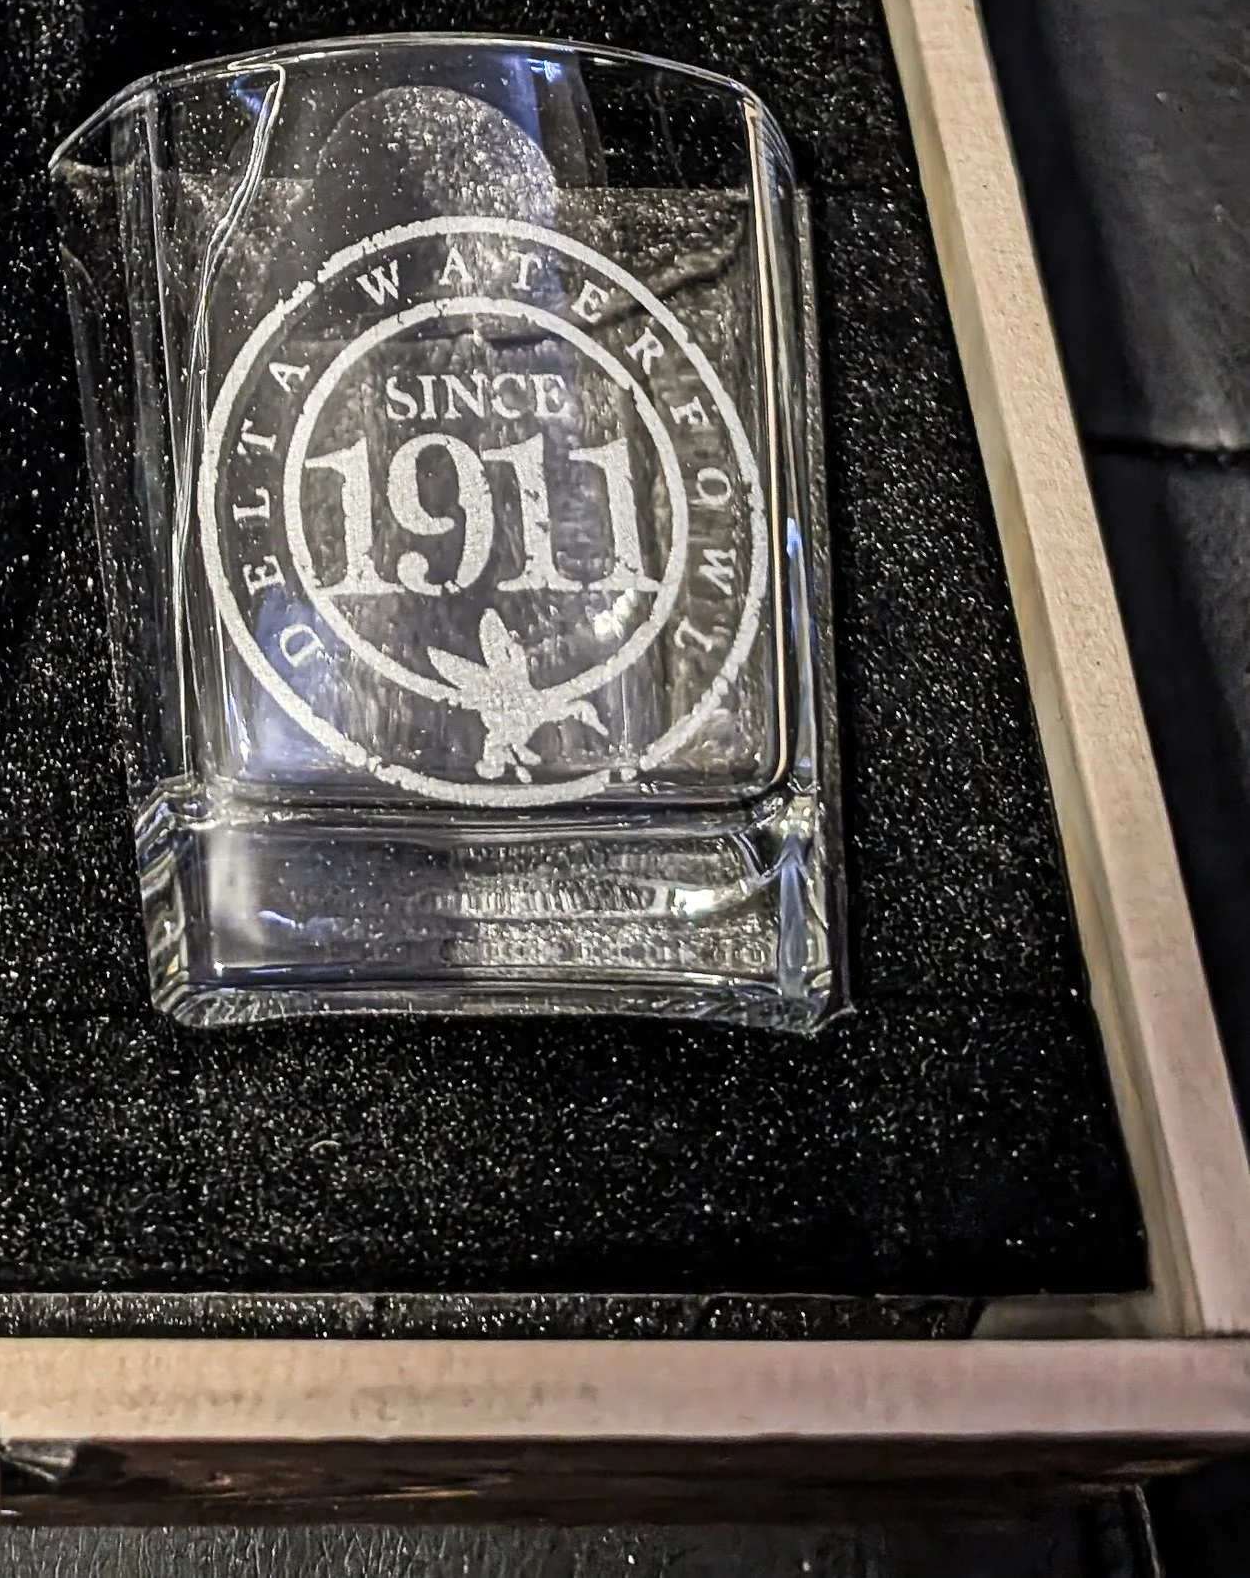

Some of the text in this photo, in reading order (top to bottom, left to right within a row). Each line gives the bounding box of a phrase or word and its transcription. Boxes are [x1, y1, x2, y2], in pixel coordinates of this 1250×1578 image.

[233, 248, 738, 668] DELTA WATERFOWL
[386, 373, 571, 421] SINCE
[305, 433, 660, 595] 1911
